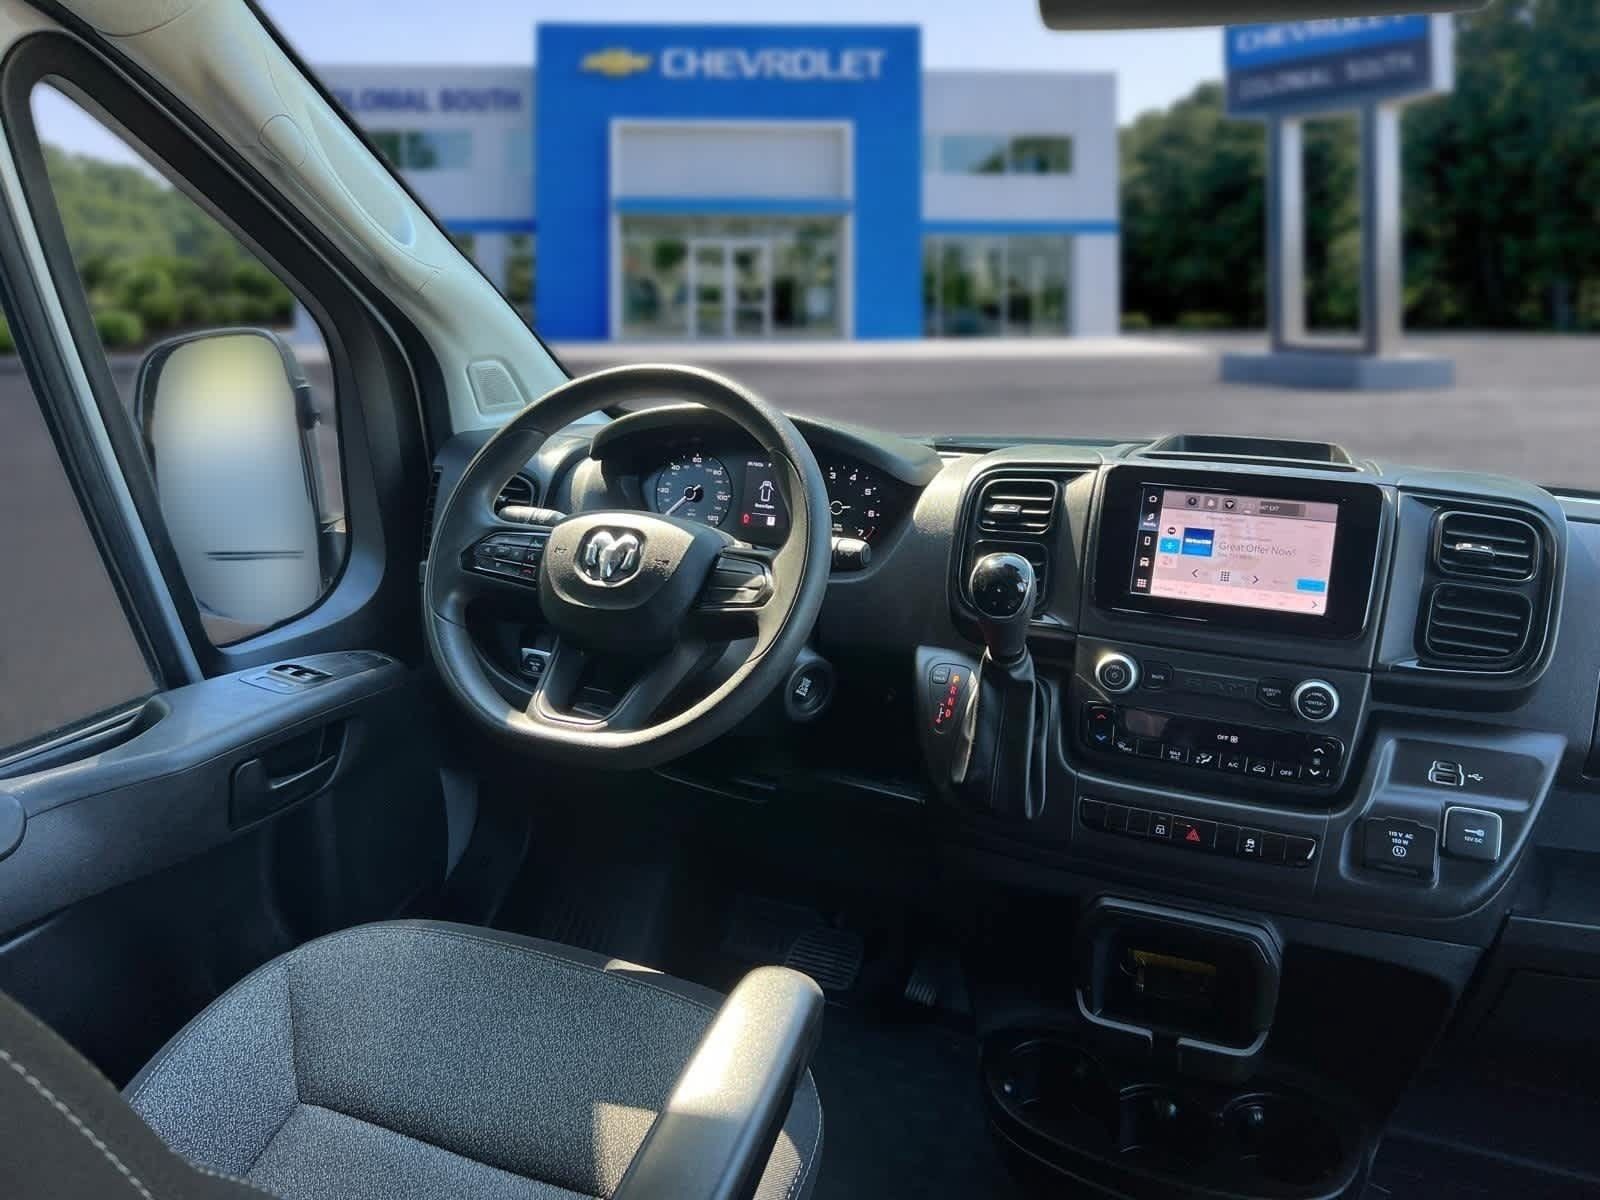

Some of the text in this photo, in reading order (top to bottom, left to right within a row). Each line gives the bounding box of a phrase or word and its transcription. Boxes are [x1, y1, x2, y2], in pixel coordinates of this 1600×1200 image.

[662, 48, 885, 79] CHEVROLET
[334, 87, 521, 113] OLONIAL SOUTH
[864, 488, 872, 496] 5
[868, 510, 875, 518] 6
[1219, 541, 1244, 552] Great
[1247, 543, 1270, 554] Offer
